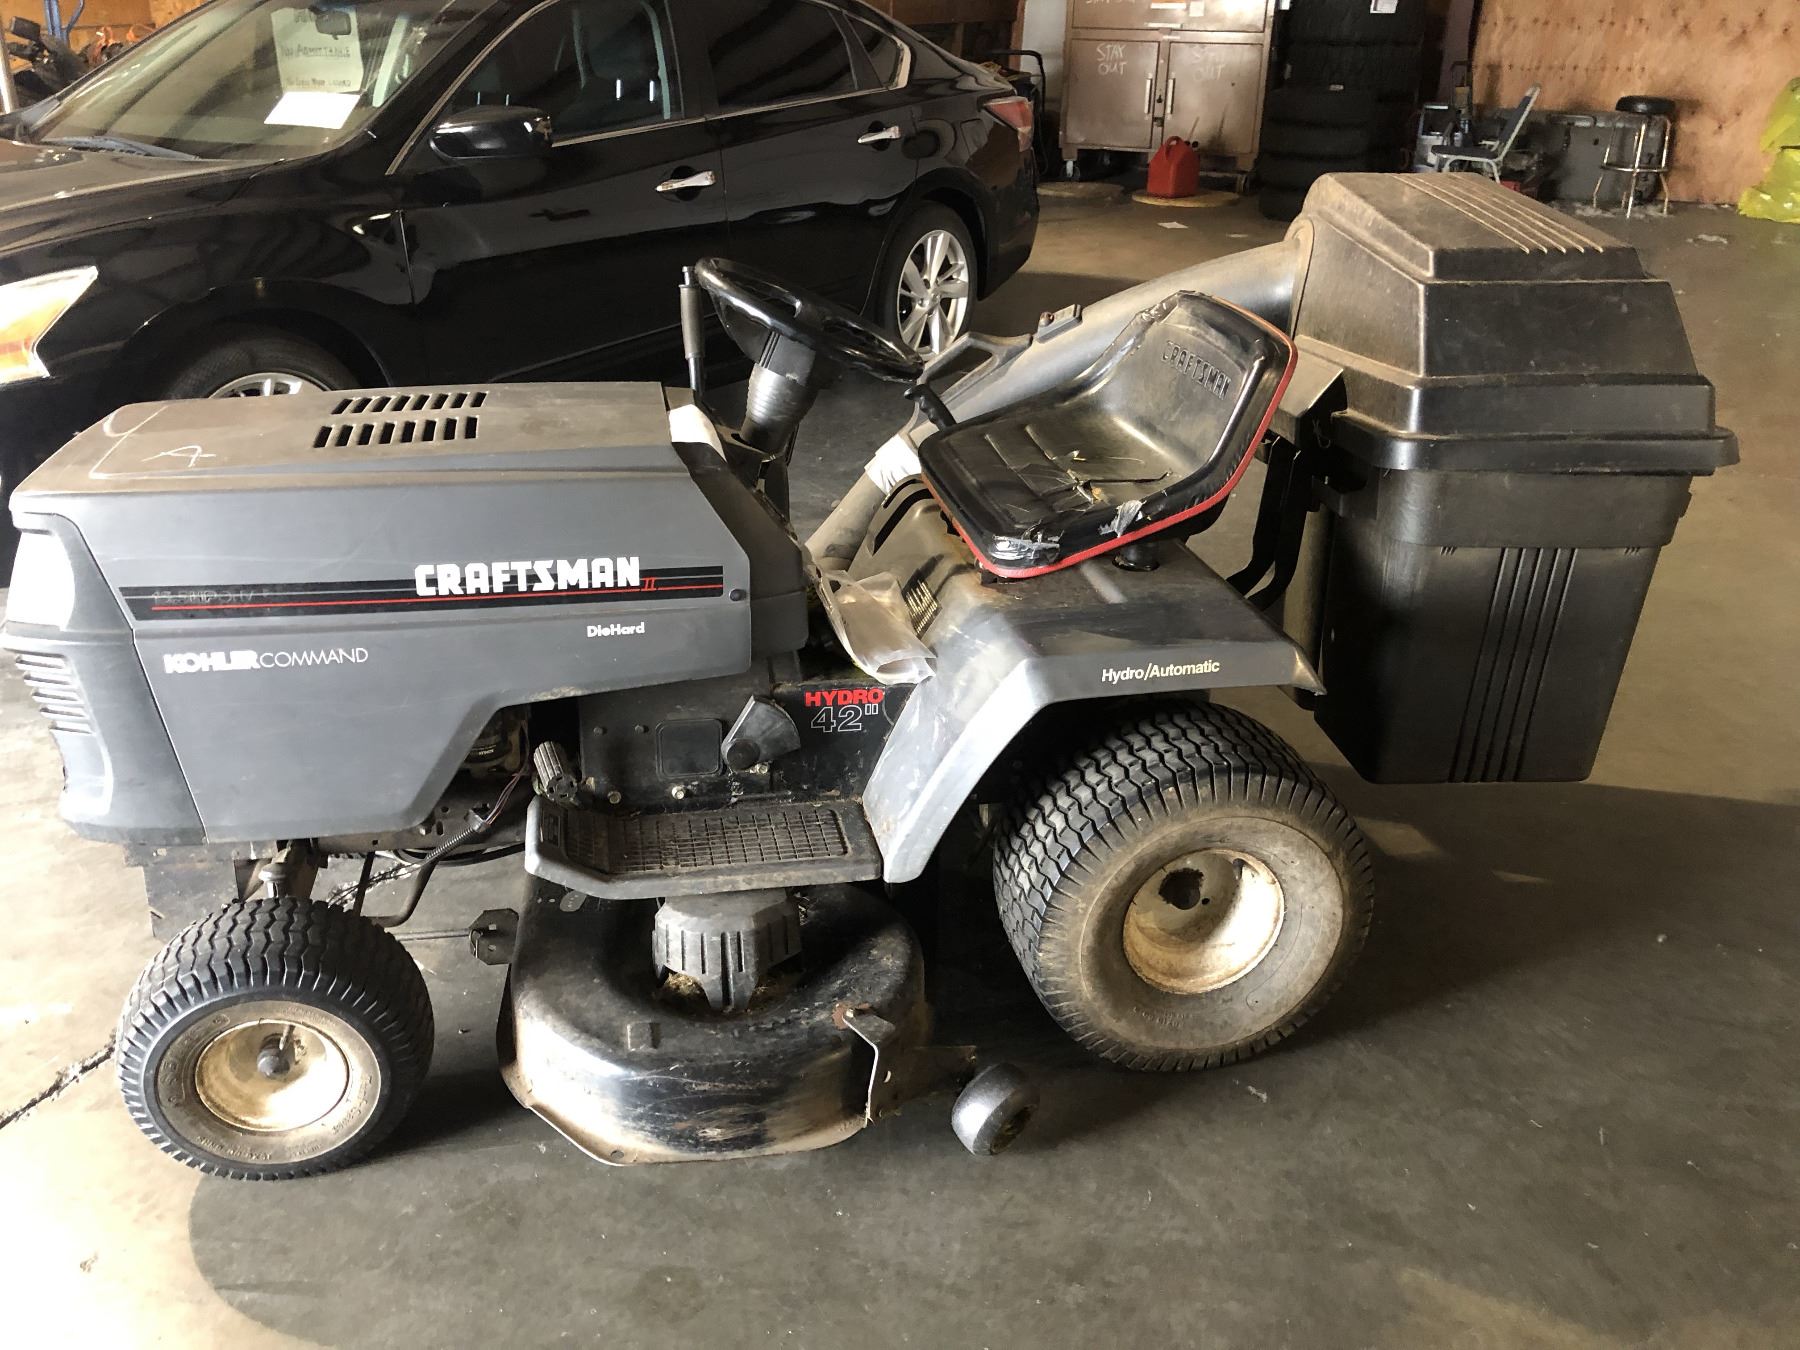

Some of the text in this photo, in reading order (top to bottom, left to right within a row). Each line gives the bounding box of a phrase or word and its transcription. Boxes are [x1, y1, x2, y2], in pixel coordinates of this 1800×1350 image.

[1096, 42, 1126, 61] STAY
[1097, 61, 1128, 76] OUT
[1161, 340, 1232, 401] CRAFTSMAN
[414, 556, 640, 597] CRAFTSMAN
[586, 622, 645, 638] DieHard
[1101, 660, 1221, 685] Hydro/Automatic
[804, 688, 884, 707] HYDRO
[810, 703, 879, 733] 42"
